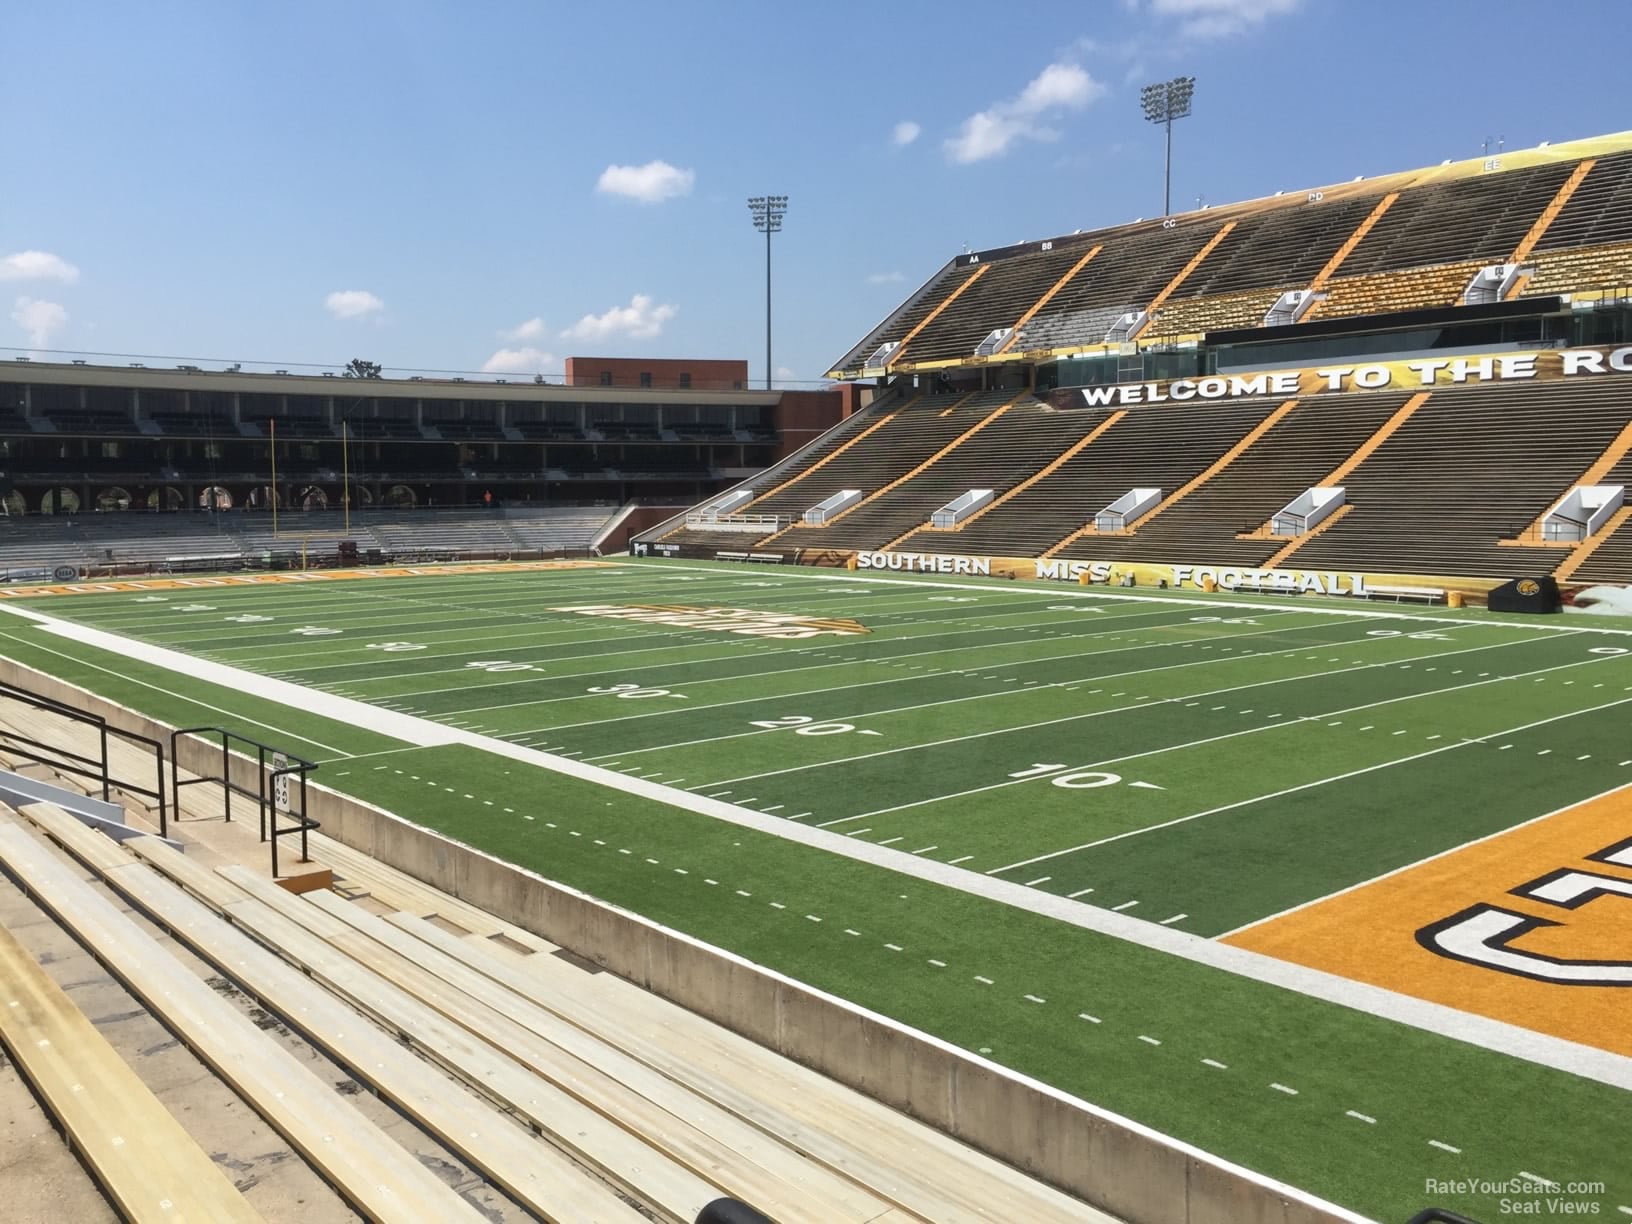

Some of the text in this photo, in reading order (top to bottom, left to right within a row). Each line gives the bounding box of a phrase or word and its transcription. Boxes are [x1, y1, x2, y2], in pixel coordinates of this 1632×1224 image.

[1163, 219, 1176, 229] CC
[969, 255, 979, 264] AA
[1081, 372, 1300, 406] WELCOME
[1318, 365, 1391, 390] TO
[1409, 354, 1538, 384] THE
[857, 552, 1368, 596] SOUTHERN MISS FOOTBALL
[587, 684, 671, 699] 30
[749, 716, 856, 736] 20
[1008, 763, 1122, 789] 10
